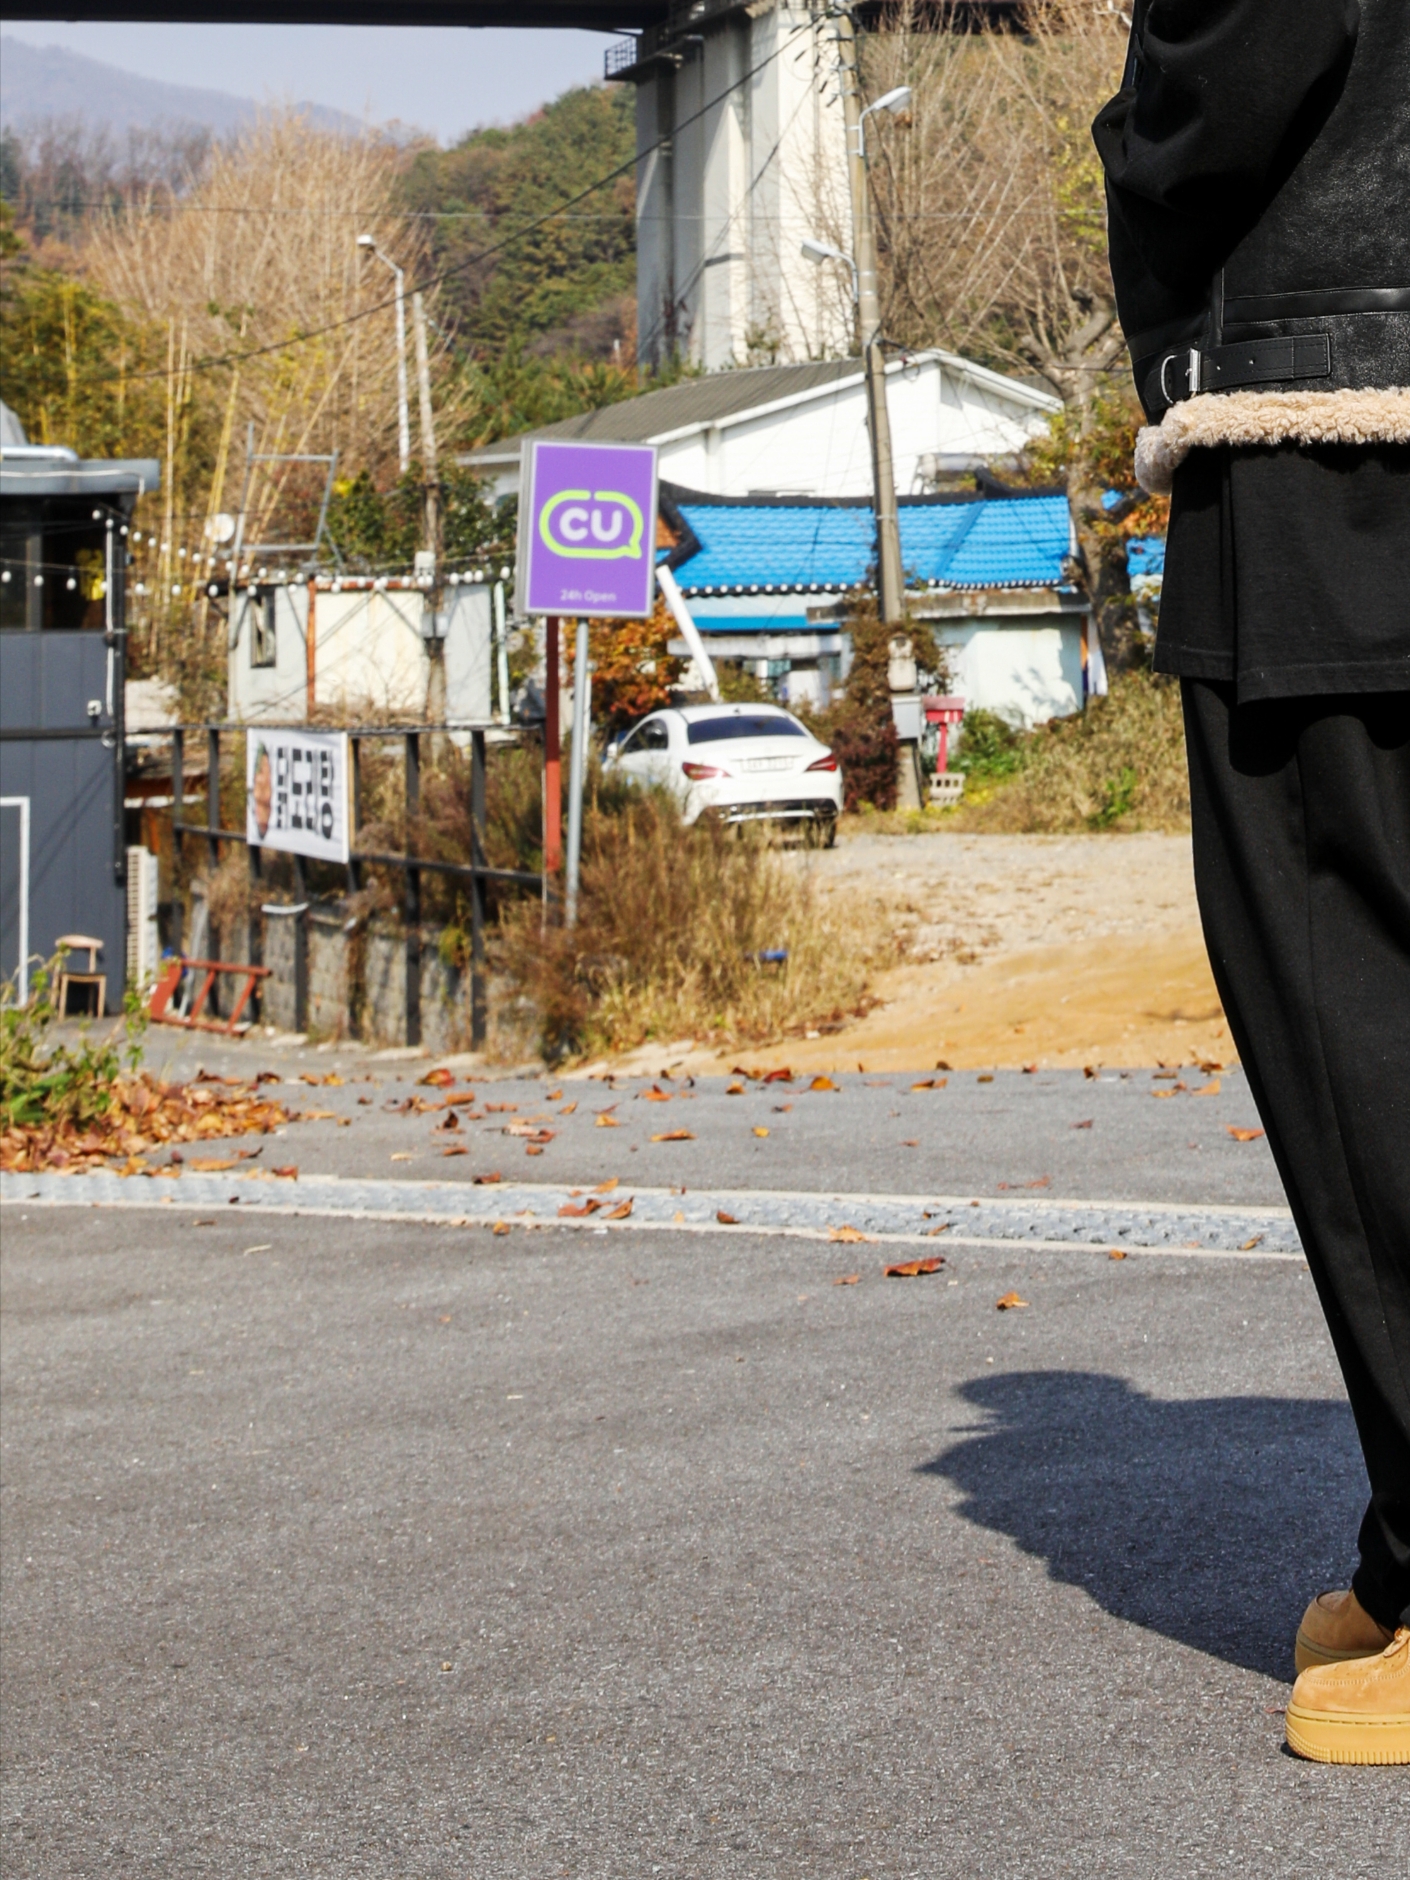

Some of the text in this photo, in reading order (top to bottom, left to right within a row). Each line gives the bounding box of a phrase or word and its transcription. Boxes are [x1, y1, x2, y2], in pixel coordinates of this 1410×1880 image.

[559, 507, 623, 542] CU
[560, 589, 617, 604] 24h Open
[277, 747, 335, 840] 닭도리탕
